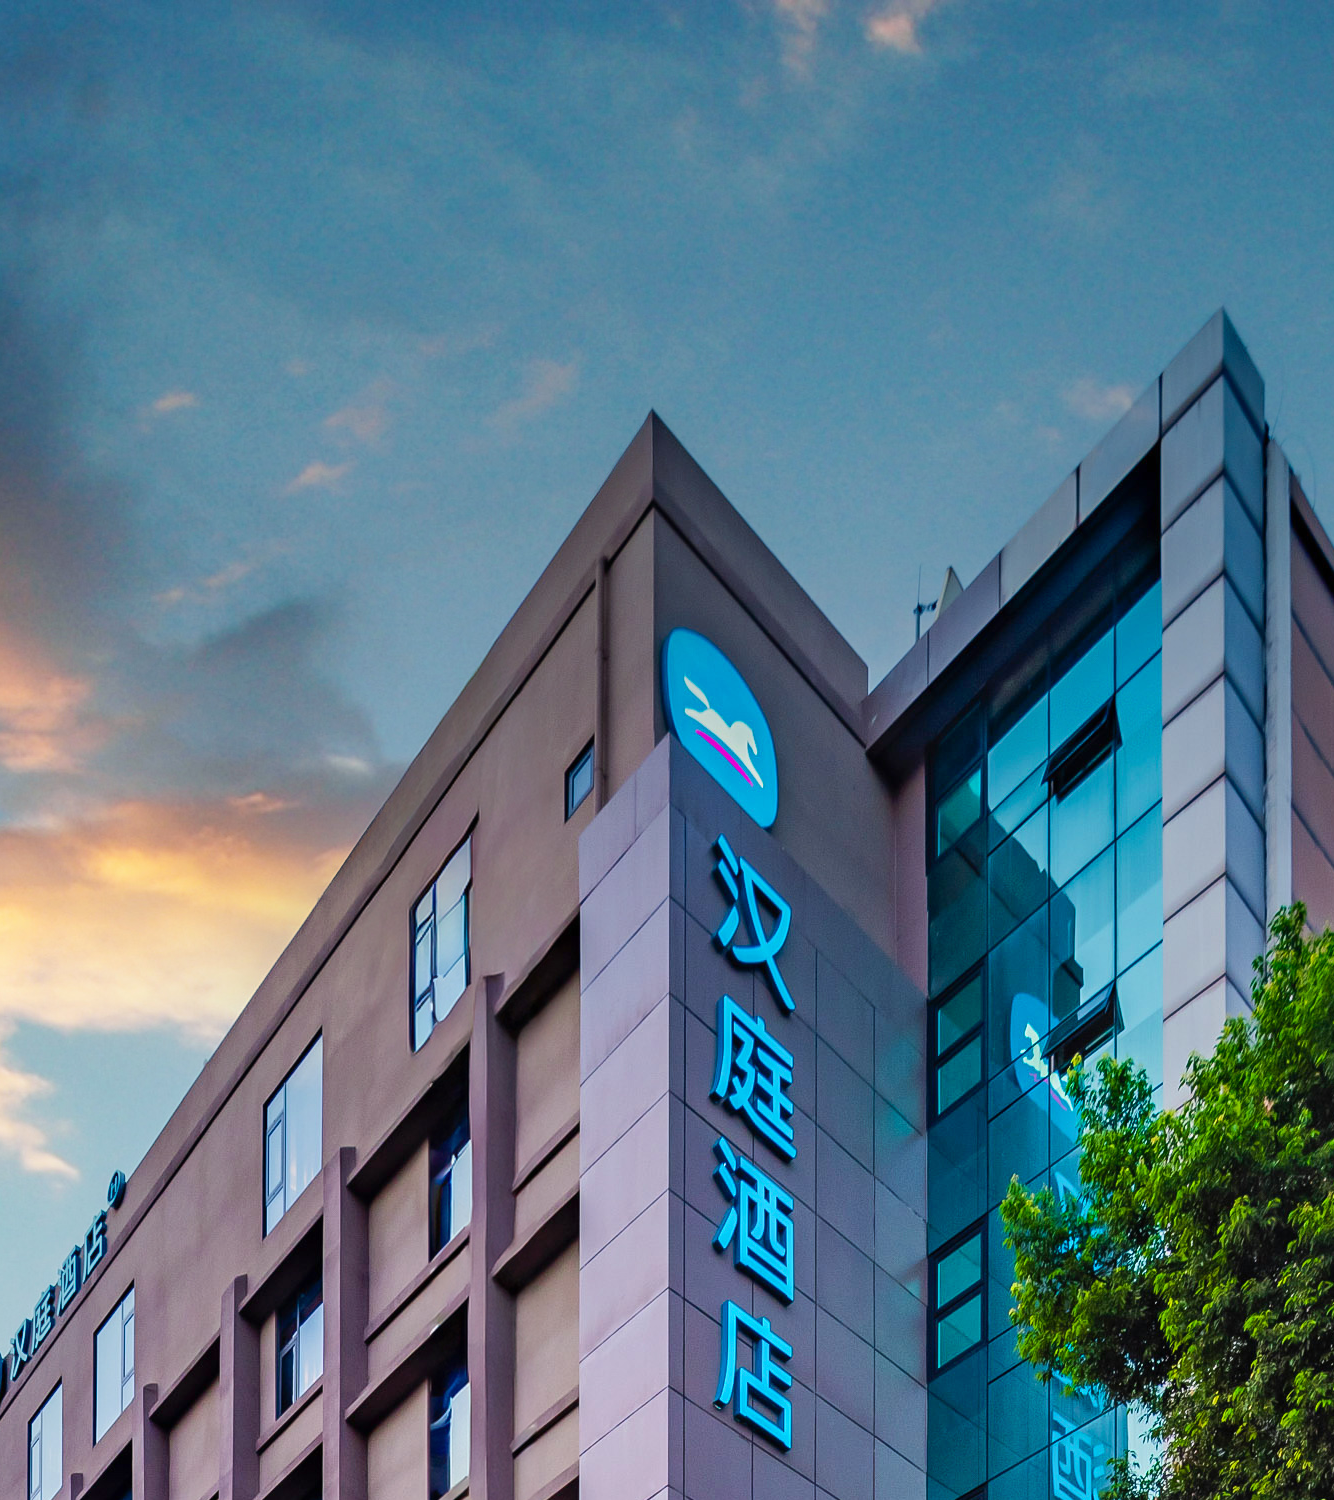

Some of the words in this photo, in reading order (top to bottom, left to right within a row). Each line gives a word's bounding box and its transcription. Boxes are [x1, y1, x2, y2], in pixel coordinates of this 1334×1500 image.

[10, 1209, 107, 1381] 汉庭酒店
[710, 833, 797, 1451] 汉庭酒店
